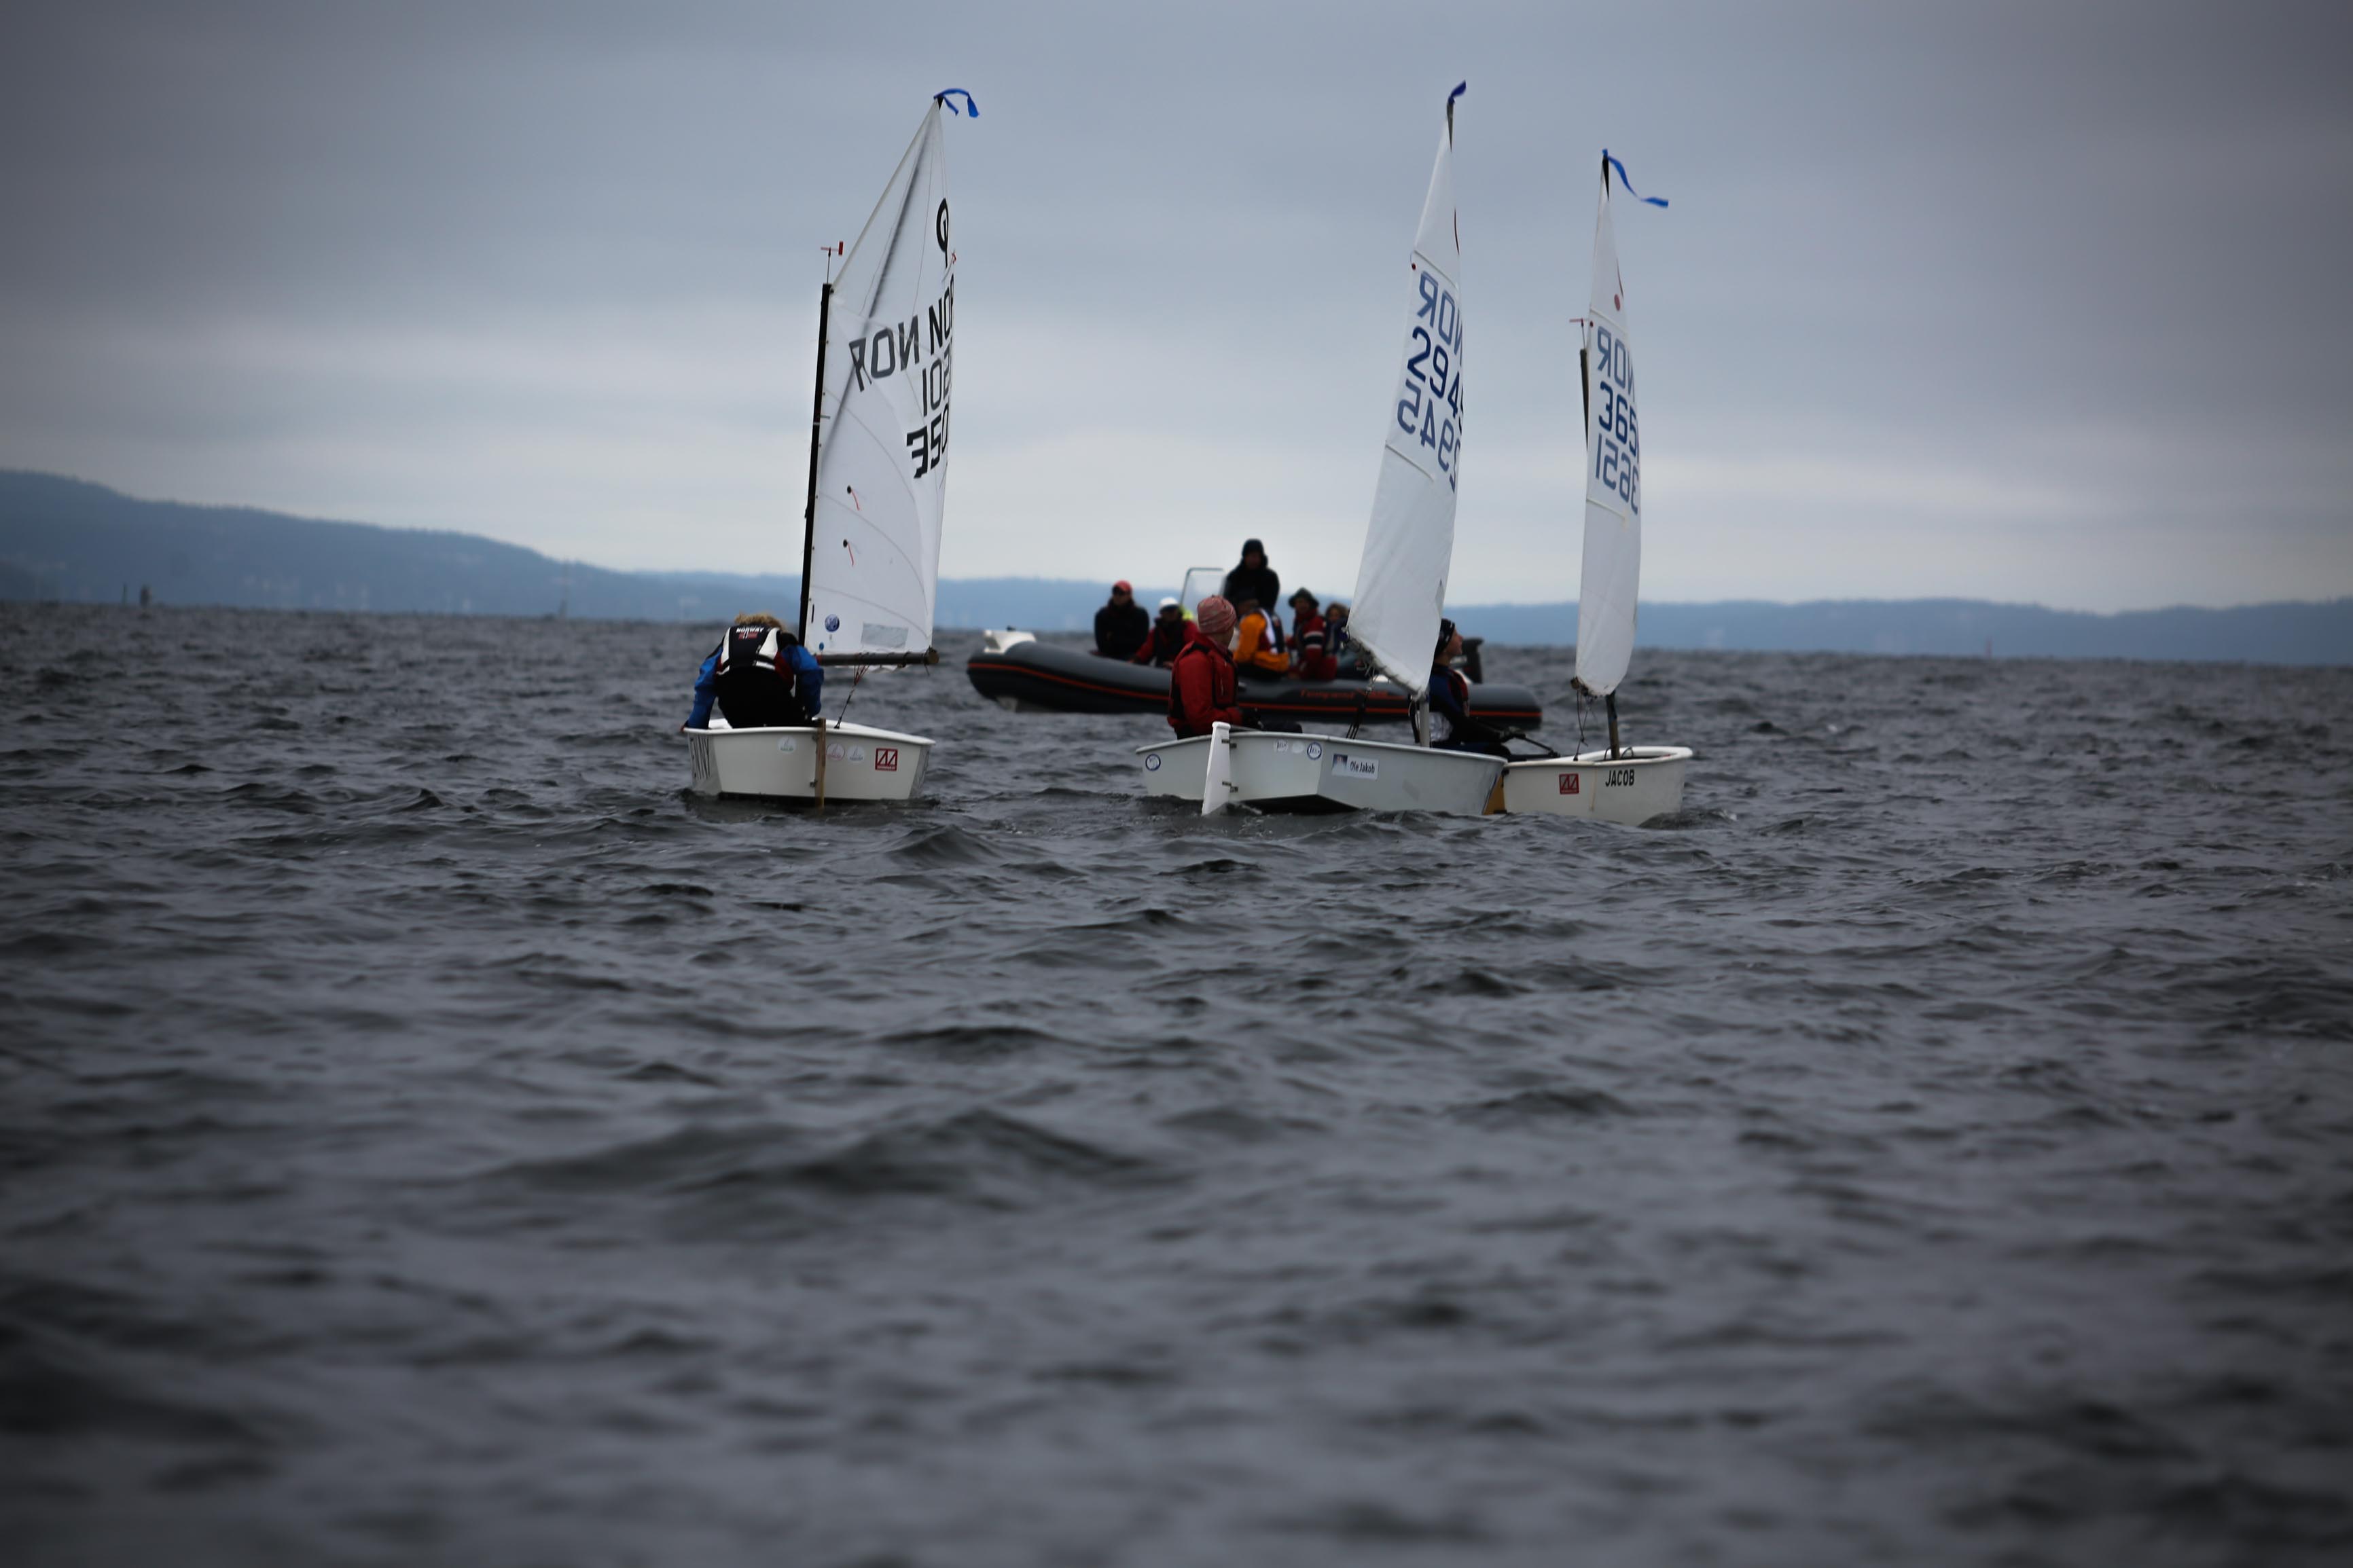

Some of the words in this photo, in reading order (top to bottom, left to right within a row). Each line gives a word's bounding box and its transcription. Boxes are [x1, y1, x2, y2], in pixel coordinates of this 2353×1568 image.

[1350, 761, 1359, 772] Ole
[1359, 761, 1375, 773] Jakob
[1605, 769, 1634, 786] JACOB
